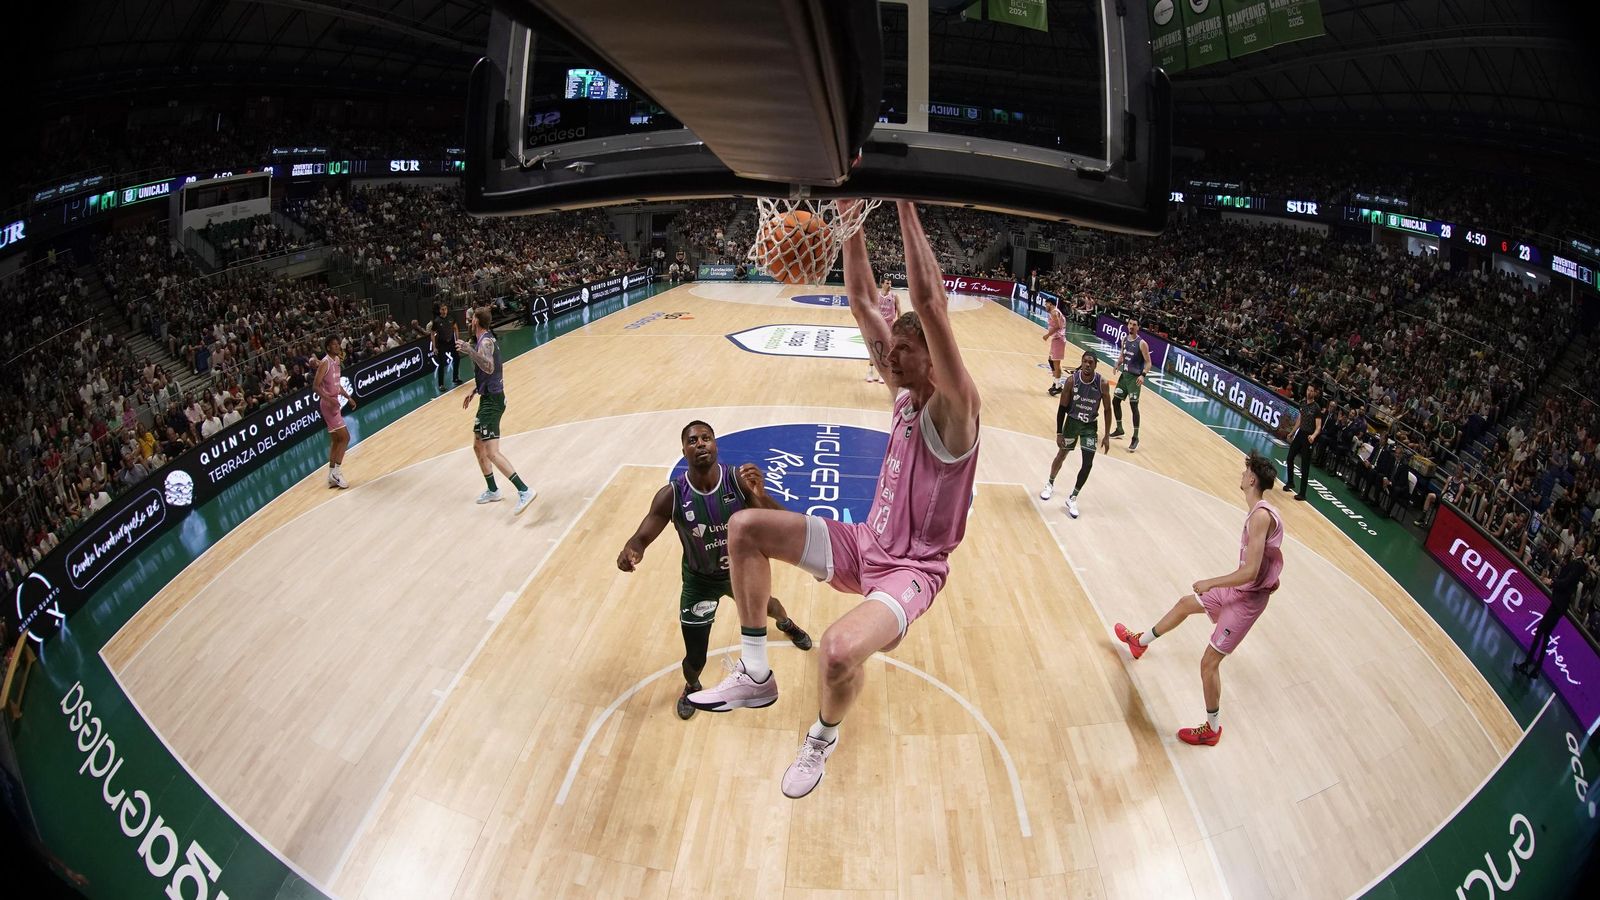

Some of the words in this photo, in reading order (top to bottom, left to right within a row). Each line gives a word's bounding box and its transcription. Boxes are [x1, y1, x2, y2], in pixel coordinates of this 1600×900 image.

[1009, 7, 1027, 17] 2024
[1227, 2, 1267, 27] CAMPEONES
[1289, 17, 1305, 28] 2025
[1186, 16, 1222, 38] CAMPEONES
[529, 126, 586, 146] endesa
[390, 160, 420, 172] SUR
[138, 182, 169, 199] UNICAJA
[1286, 200, 1318, 215] SUR
[0, 220, 26, 248] UR
[1401, 217, 1427, 232] UNICAJA
[1441, 224, 1451, 238] 28
[1465, 231, 1486, 246] 4:50
[1519, 244, 1530, 260] 23
[884, 272, 907, 280] ende
[944, 277, 967, 292] nfe
[1102, 323, 1127, 344] renfe
[1175, 354, 1209, 387] Nadie
[1212, 373, 1226, 396] te
[1229, 381, 1246, 408] da
[1249, 397, 1281, 428] más
[1077, 412, 1089, 424] 55
[200, 424, 258, 465] QUINTO
[208, 447, 257, 483] TERRAZA
[257, 435, 277, 454] DEL
[277, 410, 322, 441] CARPENA
[764, 448, 804, 502] Resort
[805, 424, 841, 521] HIGUERO
[1307, 479, 1364, 519] miguel
[709, 522, 729, 533] Unic
[72, 552, 96, 578] Combo
[1448, 538, 1524, 613] renfe
[18, 610, 38, 632] QUINTO
[38, 587, 60, 611] QUARTO
[60, 680, 229, 900] gaendesa
